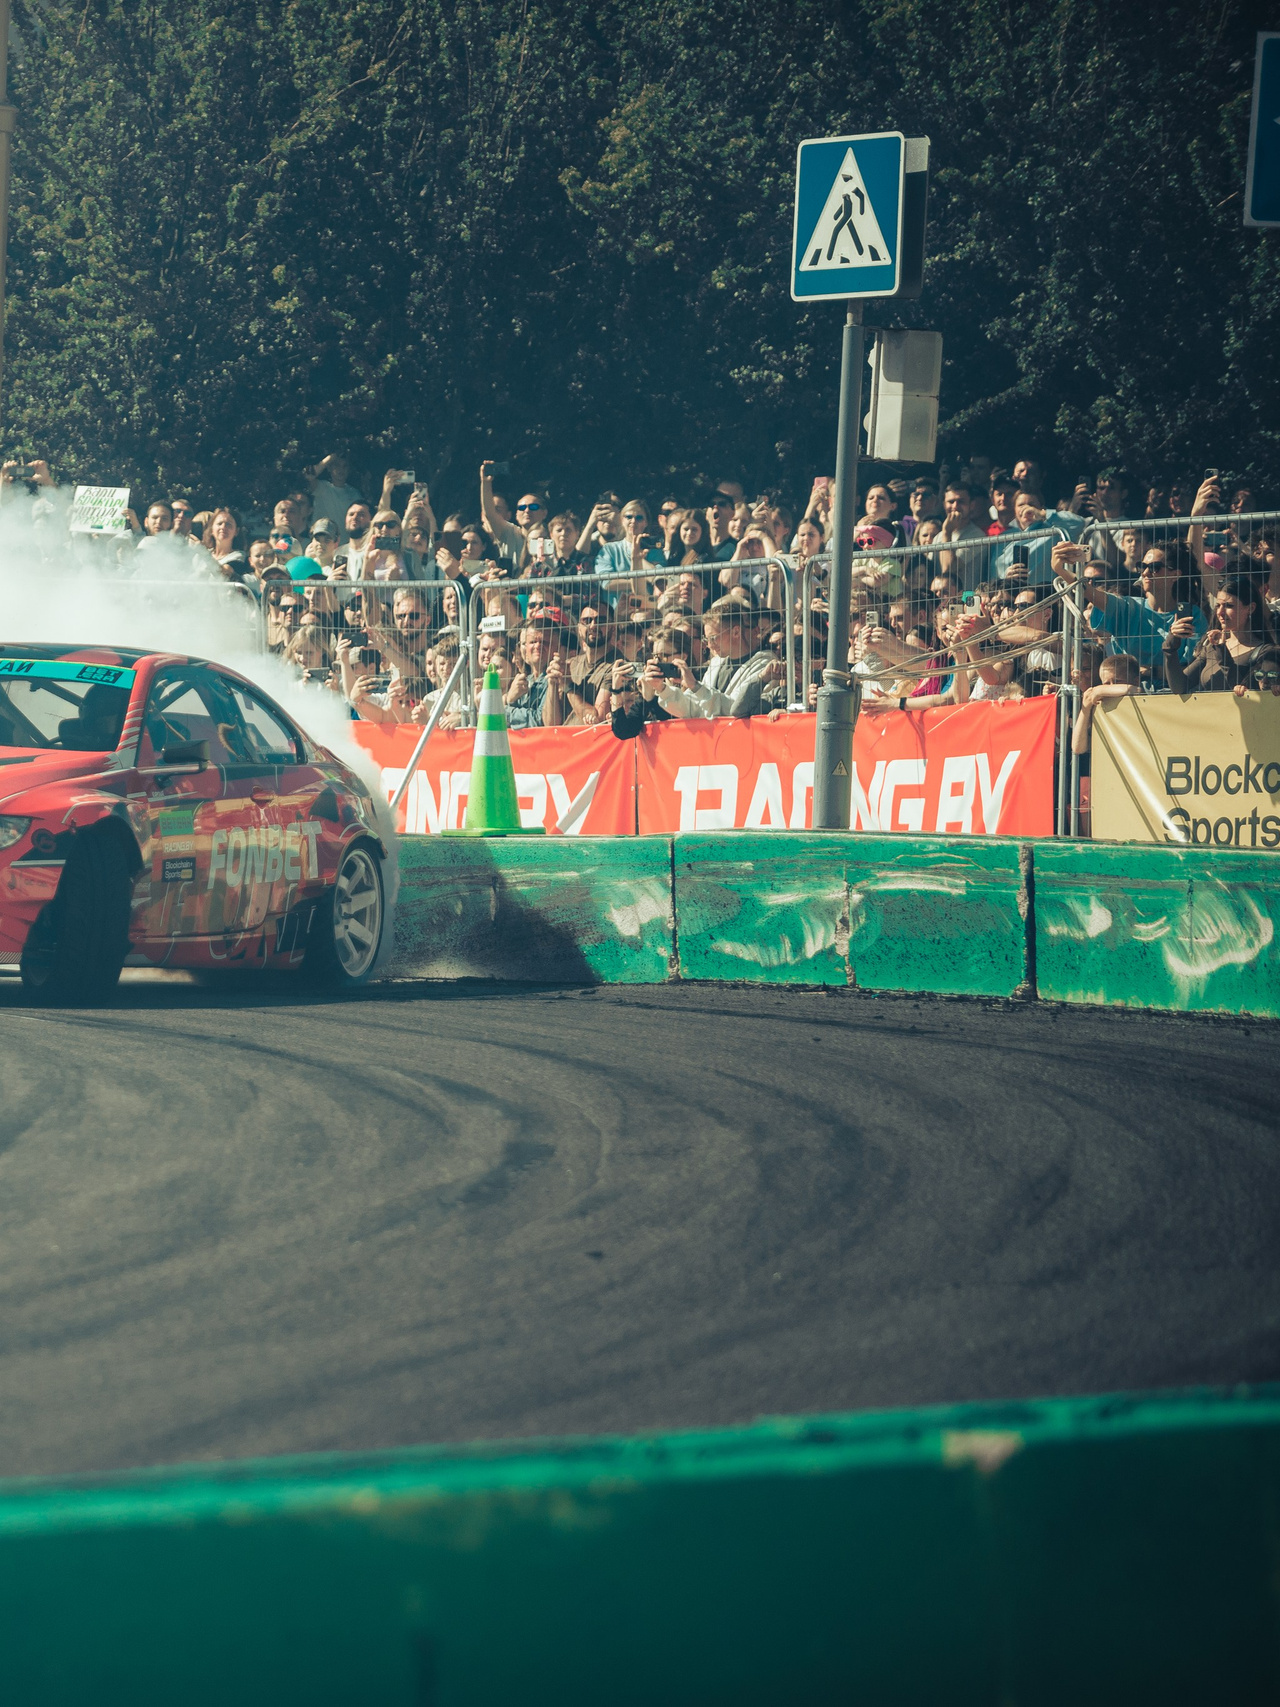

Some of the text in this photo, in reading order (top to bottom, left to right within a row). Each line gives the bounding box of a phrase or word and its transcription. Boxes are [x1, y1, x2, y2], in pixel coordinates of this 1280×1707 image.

[1165, 753, 1280, 796] Blockc
[1162, 806, 1280, 847] Sports
[207, 821, 322, 889] FONBET
